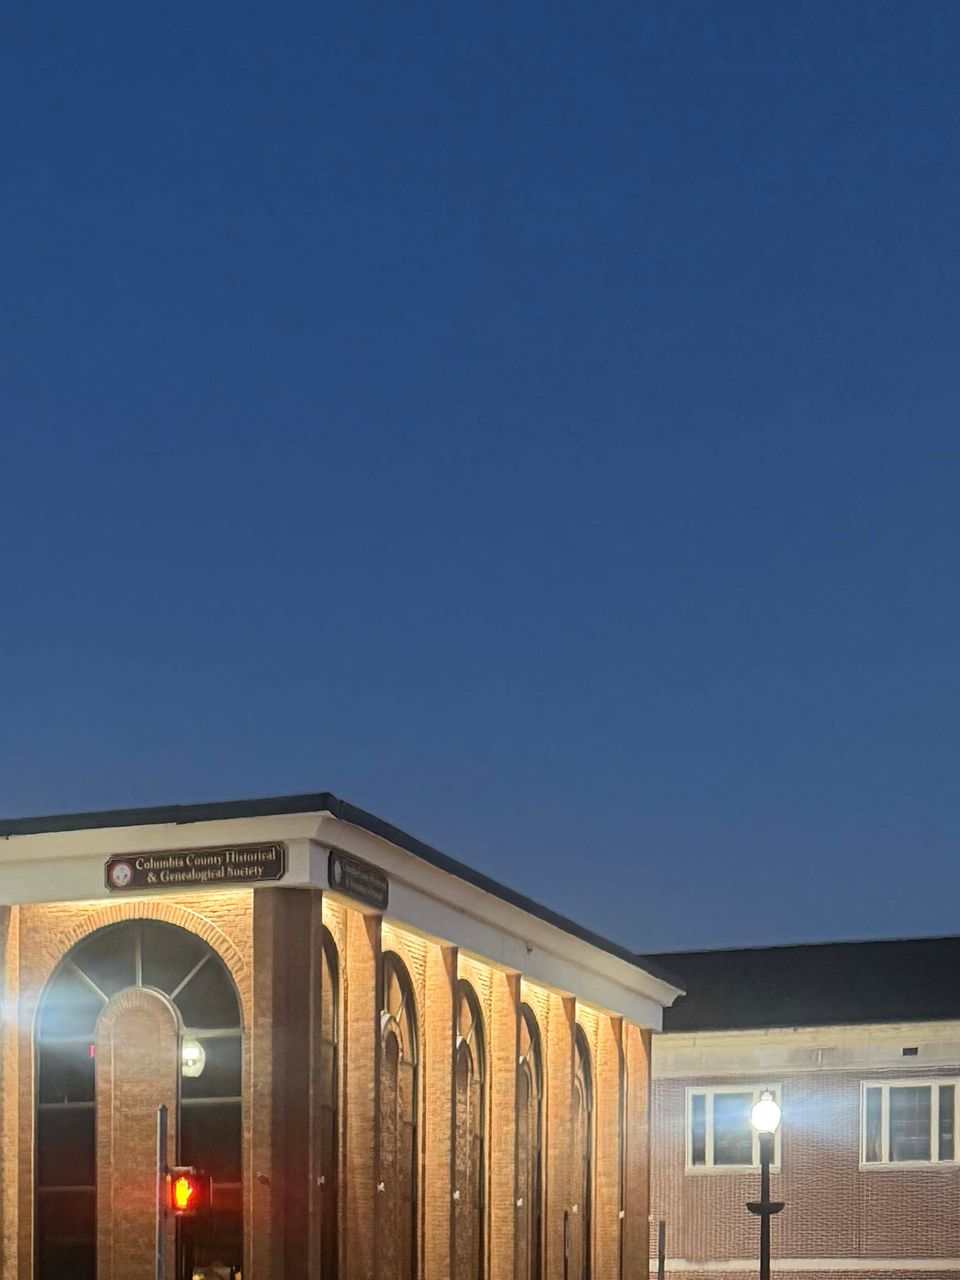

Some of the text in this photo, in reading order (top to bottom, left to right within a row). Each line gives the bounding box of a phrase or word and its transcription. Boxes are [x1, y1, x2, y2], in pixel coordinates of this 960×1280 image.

[135, 849, 276, 870] Columbia County Historical
[147, 865, 265, 883] & Genealogical Society
